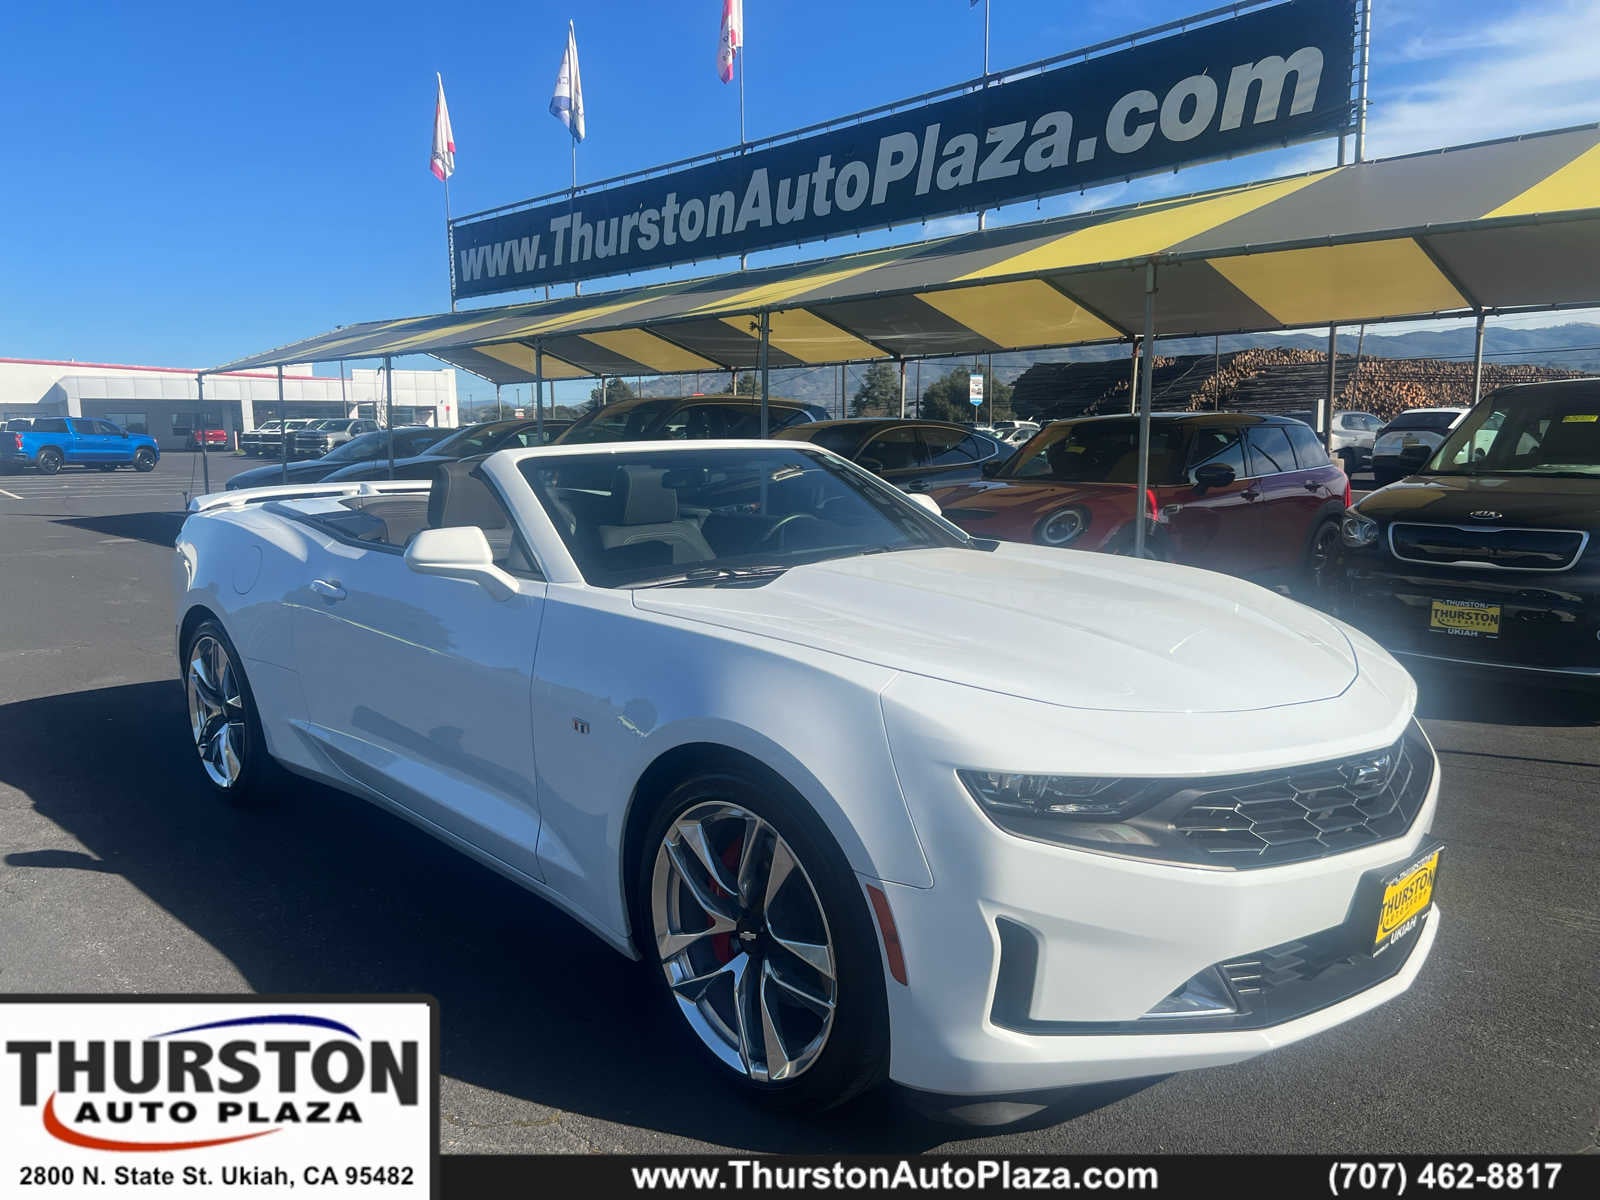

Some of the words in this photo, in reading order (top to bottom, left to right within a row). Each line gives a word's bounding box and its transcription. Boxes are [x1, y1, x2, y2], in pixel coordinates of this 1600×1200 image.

[458, 45, 1324, 283] www.ThurstonAutoPlaza.com
[1433, 608, 1499, 624] THURSTON
[1447, 628, 1478, 637] UKIAH
[1383, 869, 1434, 918] THURSTON
[1391, 915, 1417, 944] UKIAH
